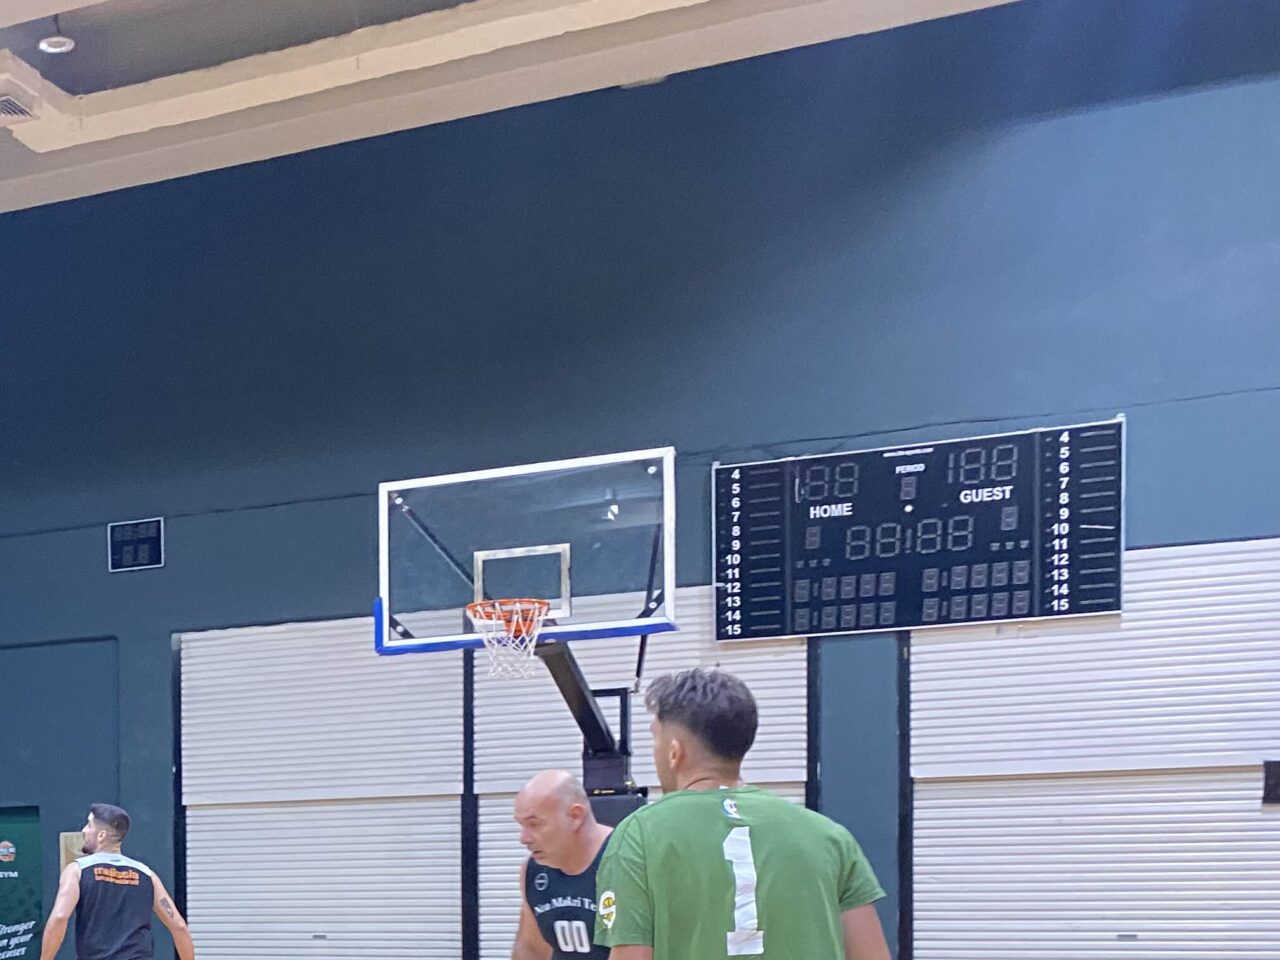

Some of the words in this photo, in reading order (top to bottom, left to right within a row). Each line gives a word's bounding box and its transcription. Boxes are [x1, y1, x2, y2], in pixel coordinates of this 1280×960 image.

[1059, 431, 1070, 443] 4
[1059, 446, 1070, 459] 5
[731, 468, 741, 479] 4
[1059, 462, 1070, 474] 6
[731, 483, 741, 494] 5
[1059, 477, 1070, 489] 7
[959, 486, 1014, 503] GUEST
[1059, 492, 1070, 504] 8
[731, 497, 741, 508] 6
[731, 511, 741, 522] 7
[809, 503, 853, 518] HOME
[1059, 507, 1070, 519] 9
[731, 525, 741, 536] 8
[1051, 523, 1069, 535] 10
[731, 540, 741, 551] 9
[1051, 538, 1069, 550] 11
[725, 554, 741, 565] 10
[1051, 553, 1069, 565] 12
[725, 568, 741, 578] 11
[1051, 568, 1069, 580] 13
[725, 582, 741, 593] 12
[1051, 583, 1069, 596] 14
[725, 596, 741, 607] 13
[1051, 599, 1069, 611] 15
[725, 610, 741, 621] 14
[725, 624, 741, 635] 15
[723, 826, 764, 956] 1
[8, 933, 34, 949] your
[554, 920, 591, 953] 00
